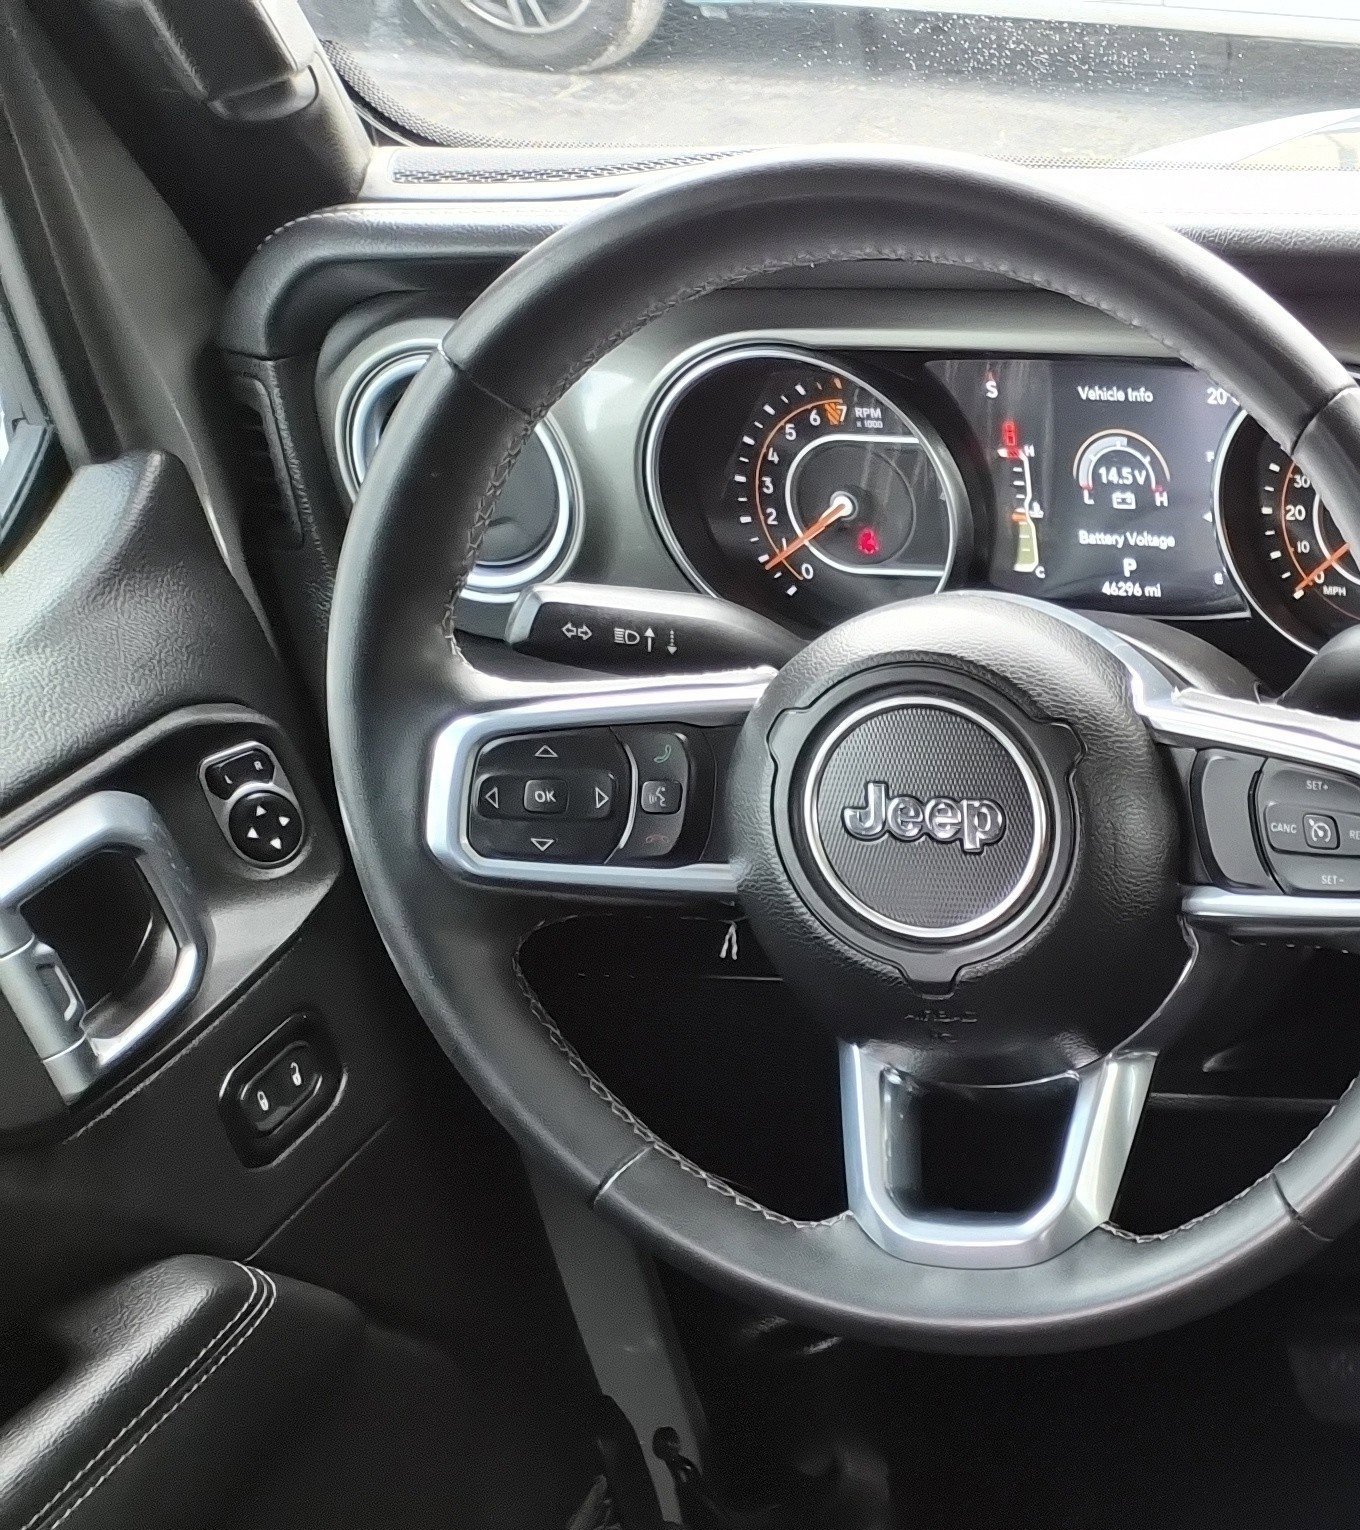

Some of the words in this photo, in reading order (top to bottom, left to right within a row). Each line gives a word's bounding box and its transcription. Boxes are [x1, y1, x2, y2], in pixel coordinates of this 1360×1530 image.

[986, 380, 998, 398] S
[1077, 386, 1125, 402] Vehicle
[1128, 386, 1154, 402] Info
[809, 410, 820, 426] 6
[838, 405, 848, 421] 7
[855, 407, 882, 419] RPM
[785, 424, 797, 441] 5
[767, 447, 779, 464] 4
[1099, 466, 1133, 485] 14.5
[1134, 468, 1147, 485] V
[1293, 475, 1310, 489] 30
[762, 477, 774, 494] 3
[1083, 489, 1095, 505] L
[1155, 492, 1168, 507] H
[766, 508, 778, 525] 2
[1286, 505, 1306, 521] 20
[1079, 530, 1124, 548] Battery
[1126, 531, 1175, 550] Voltage
[1297, 540, 1310, 554] 10
[801, 563, 814, 579] 0
[1122, 558, 1138, 577] P
[1102, 581, 1142, 597] 46296
[1144, 583, 1162, 598] mi
[1323, 585, 1347, 597] MPH
[534, 790, 557, 803] OK
[843, 781, 1006, 853] Jeep
[1270, 822, 1298, 834] CANC
